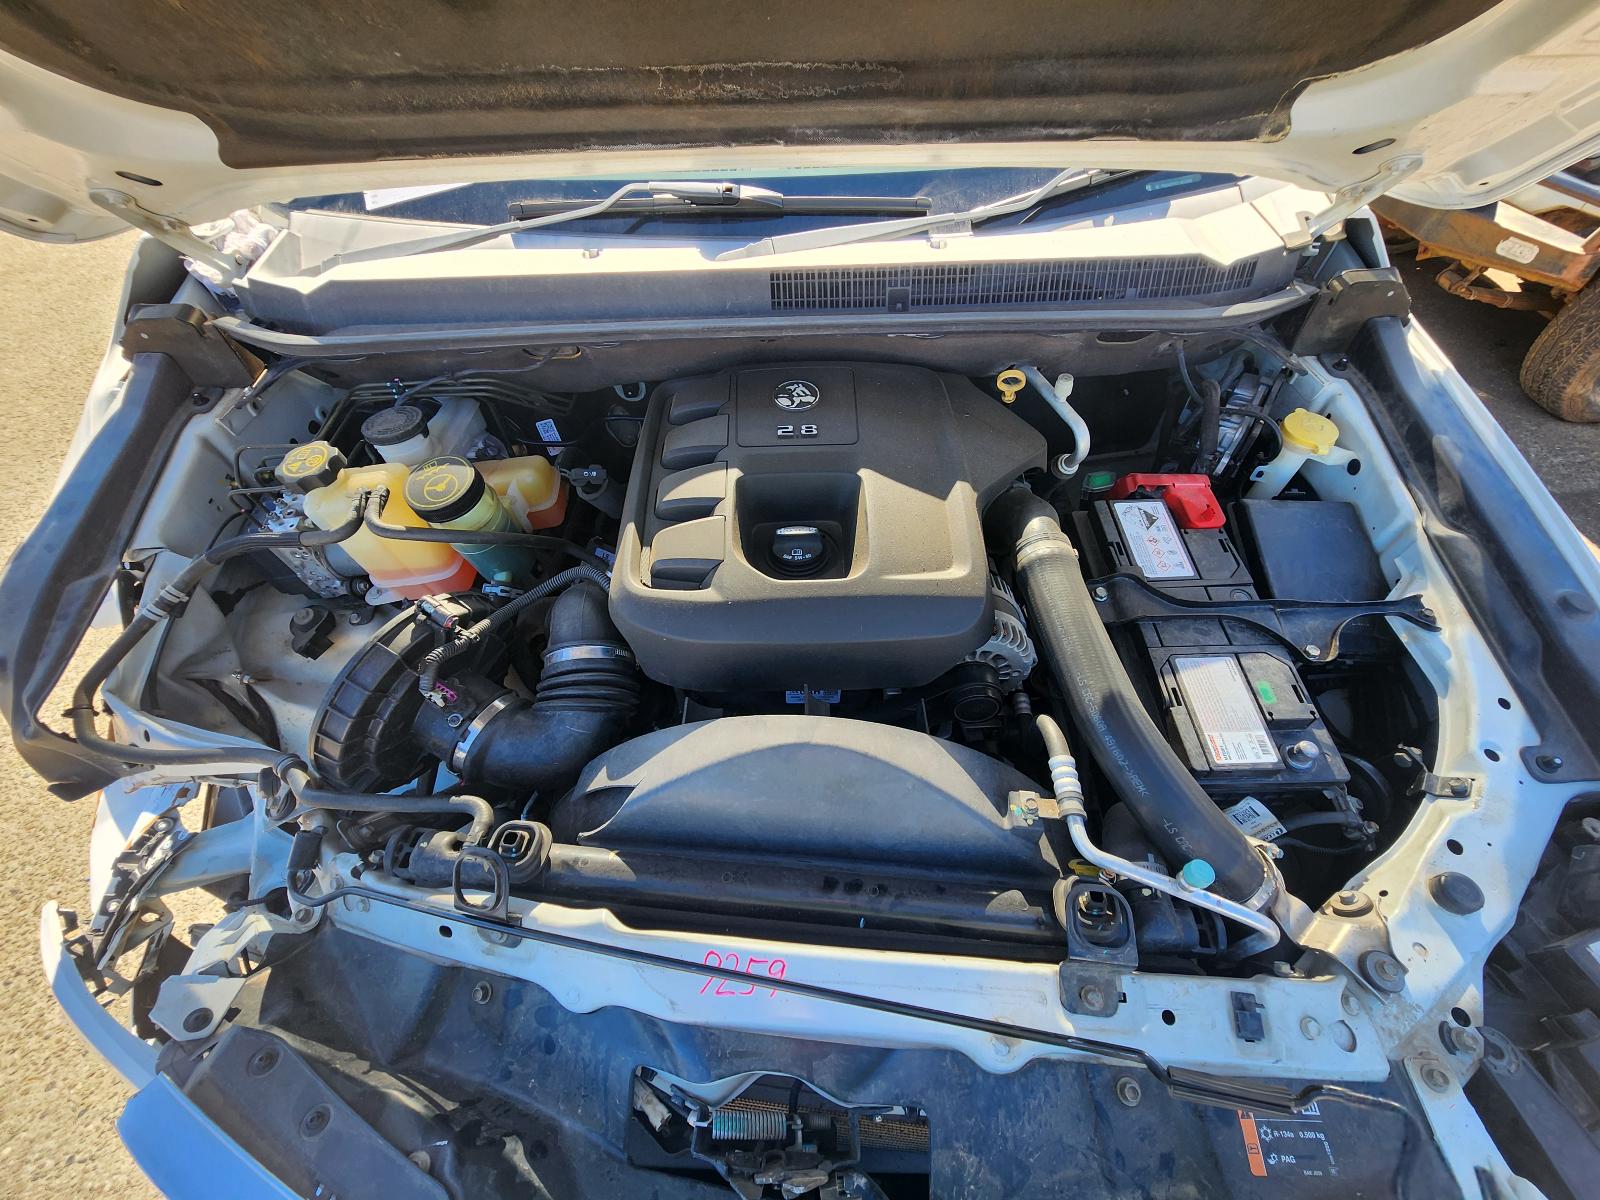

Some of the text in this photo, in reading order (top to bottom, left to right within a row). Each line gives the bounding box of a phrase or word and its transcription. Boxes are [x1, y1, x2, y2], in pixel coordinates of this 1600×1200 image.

[1273, 1130, 1325, 1141] R-134a 0.500 kg
[1281, 1155, 1296, 1164] PAG
